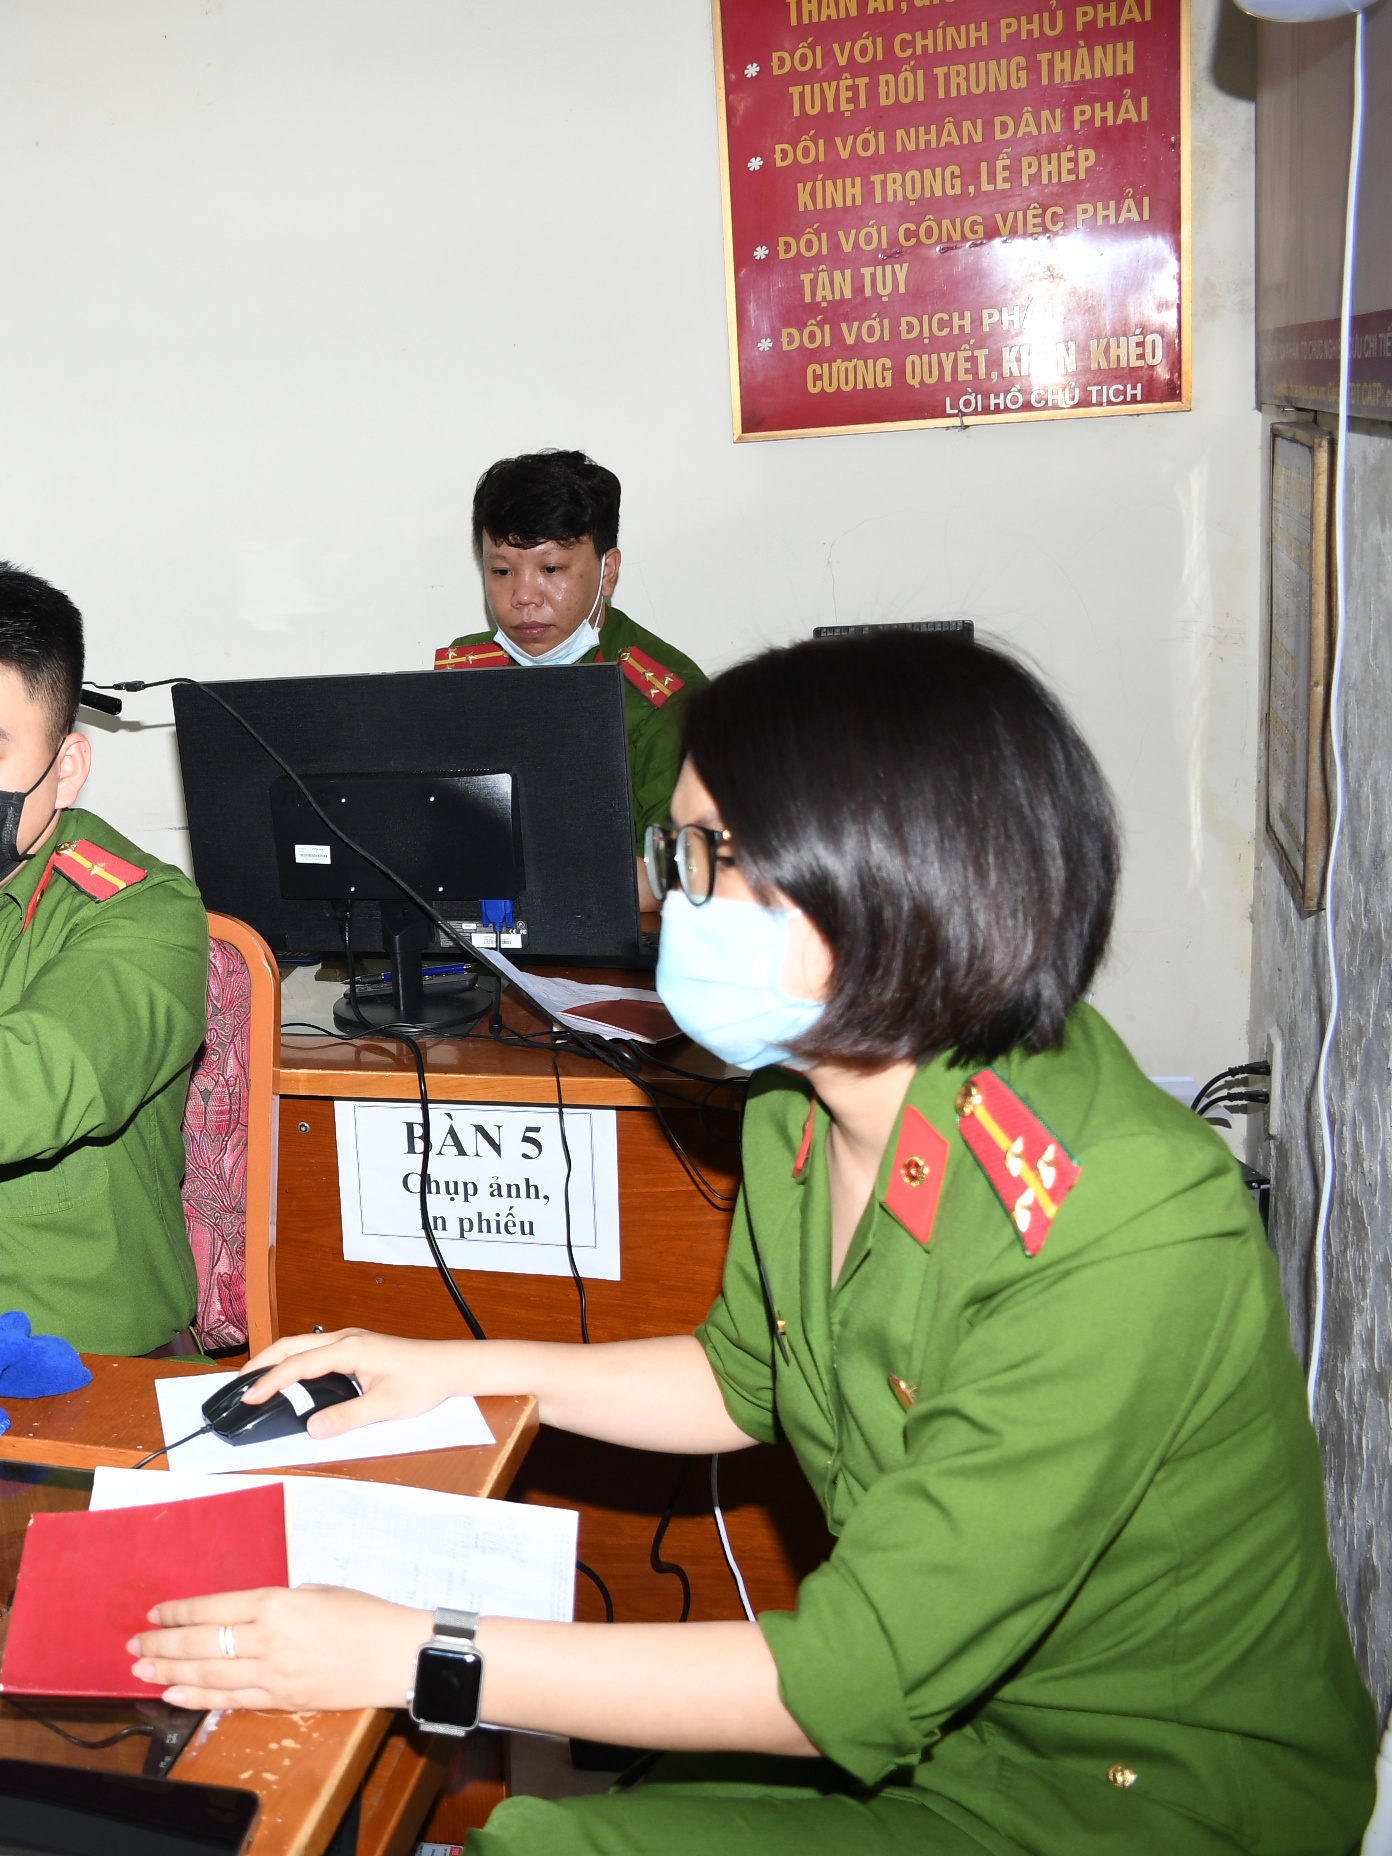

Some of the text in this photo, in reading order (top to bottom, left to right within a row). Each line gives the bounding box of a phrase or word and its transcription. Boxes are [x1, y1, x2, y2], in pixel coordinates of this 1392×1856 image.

[771, 37, 823, 75] ĐỐI
[832, 31, 883, 66] VỚI
[894, 21, 988, 58] CHÍNH
[1000, 0, 1063, 43] PHỦ
[789, 40, 1135, 117] TUYỆT ĐỐI TRUNG THÀNH
[774, 88, 1149, 167] ĐỐI VỚI NHÂN DÂN PHẢI
[797, 174, 862, 212] KÍNH
[1021, 144, 1096, 187] PHÉP
[777, 188, 1150, 260] ĐỐI VỚI CÔNG VIỆC PHẢI
[800, 262, 909, 308] TẬN TỤY
[780, 315, 831, 351] ĐỐI
[840, 312, 890, 345] VỚI
[899, 310, 972, 344] ĐỊCH
[806, 357, 893, 394] CƯƠNG
[1002, 340, 1077, 378] KHN
[1090, 328, 1163, 371] KHÉO
[945, 382, 1142, 414] LỜI HỒ CHỦ TỊCH
[402, 1113, 543, 1160] BÀN 5
[402, 1172, 550, 1206] Chụp ảnh,
[457, 1206, 536, 1239] phiếu
